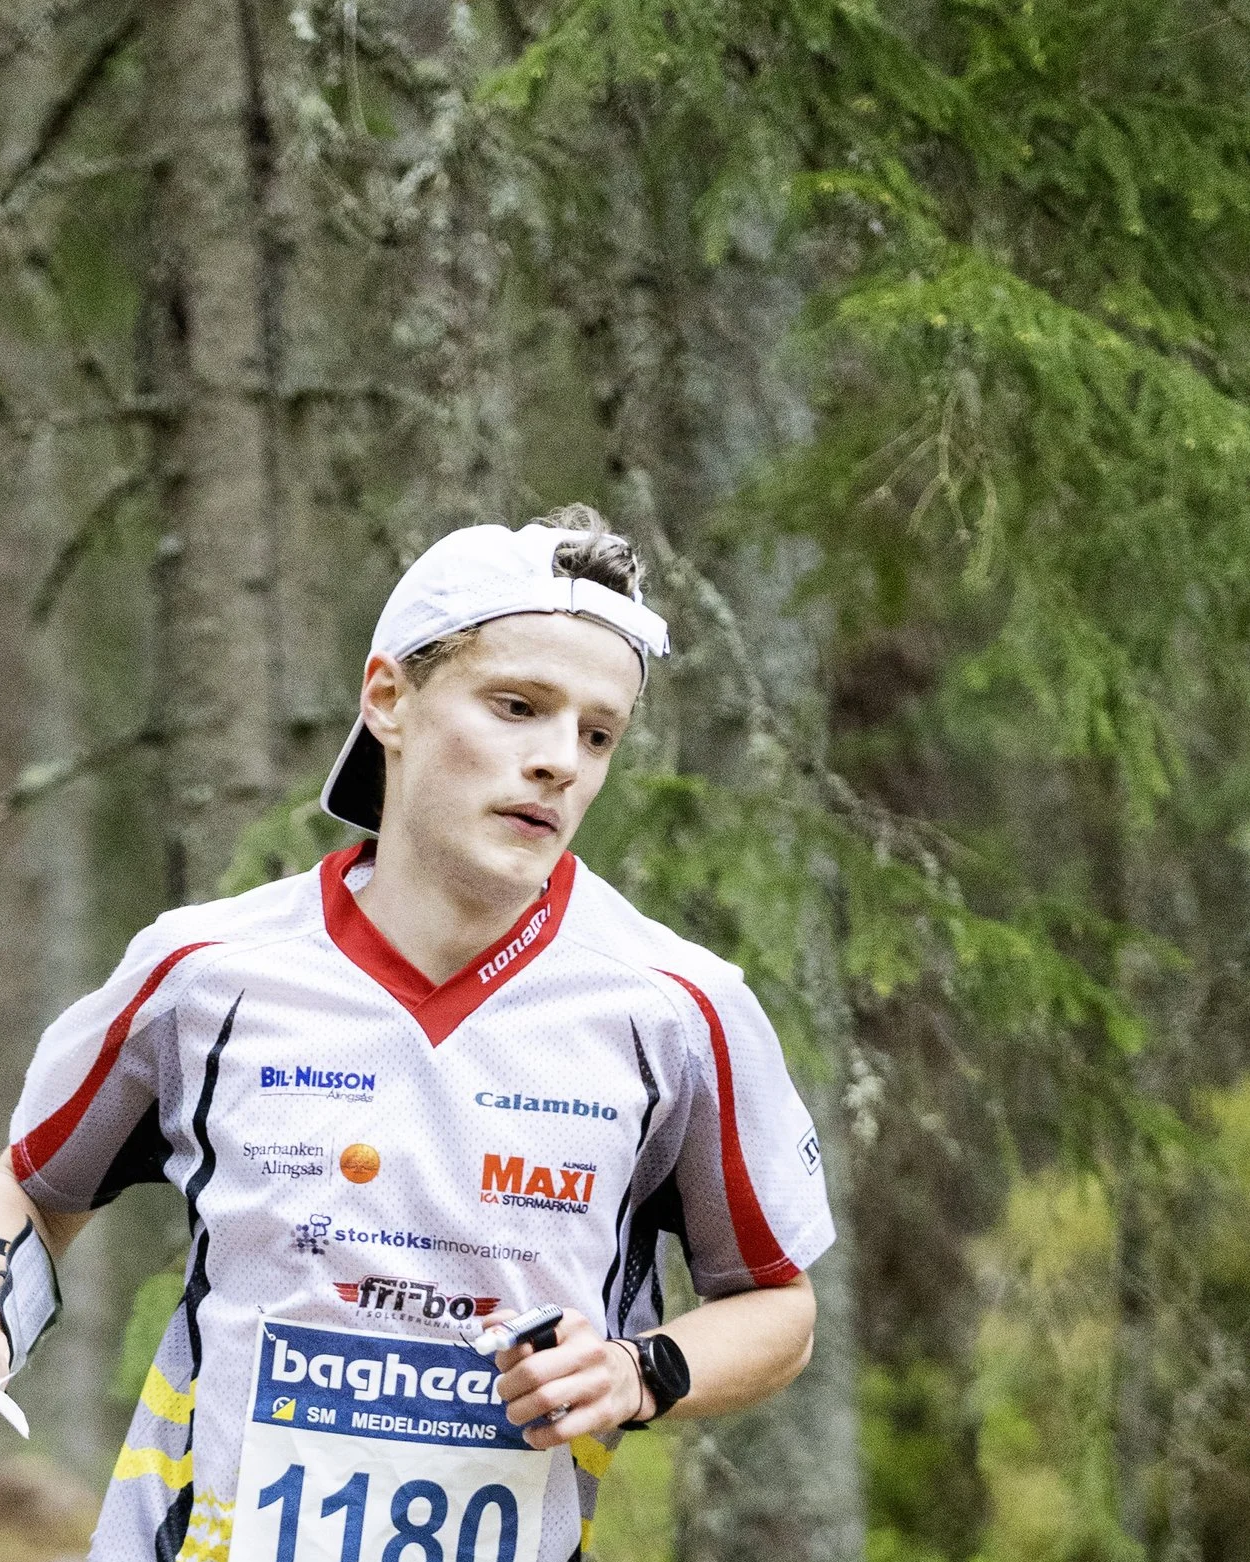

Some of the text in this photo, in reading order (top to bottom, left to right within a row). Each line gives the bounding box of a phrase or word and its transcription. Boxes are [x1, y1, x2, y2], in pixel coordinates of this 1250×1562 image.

[475, 1091, 618, 1121] Calambio
[243, 1142, 324, 1160] Sparbanken
[261, 1160, 324, 1179] Alingsås
[481, 1153, 595, 1203] MAXI
[480, 1192, 589, 1214] ICA STORMARKNAD
[334, 1228, 541, 1263] storköksinnovationer
[307, 1406, 498, 1440] SM MEDELDISTANS
